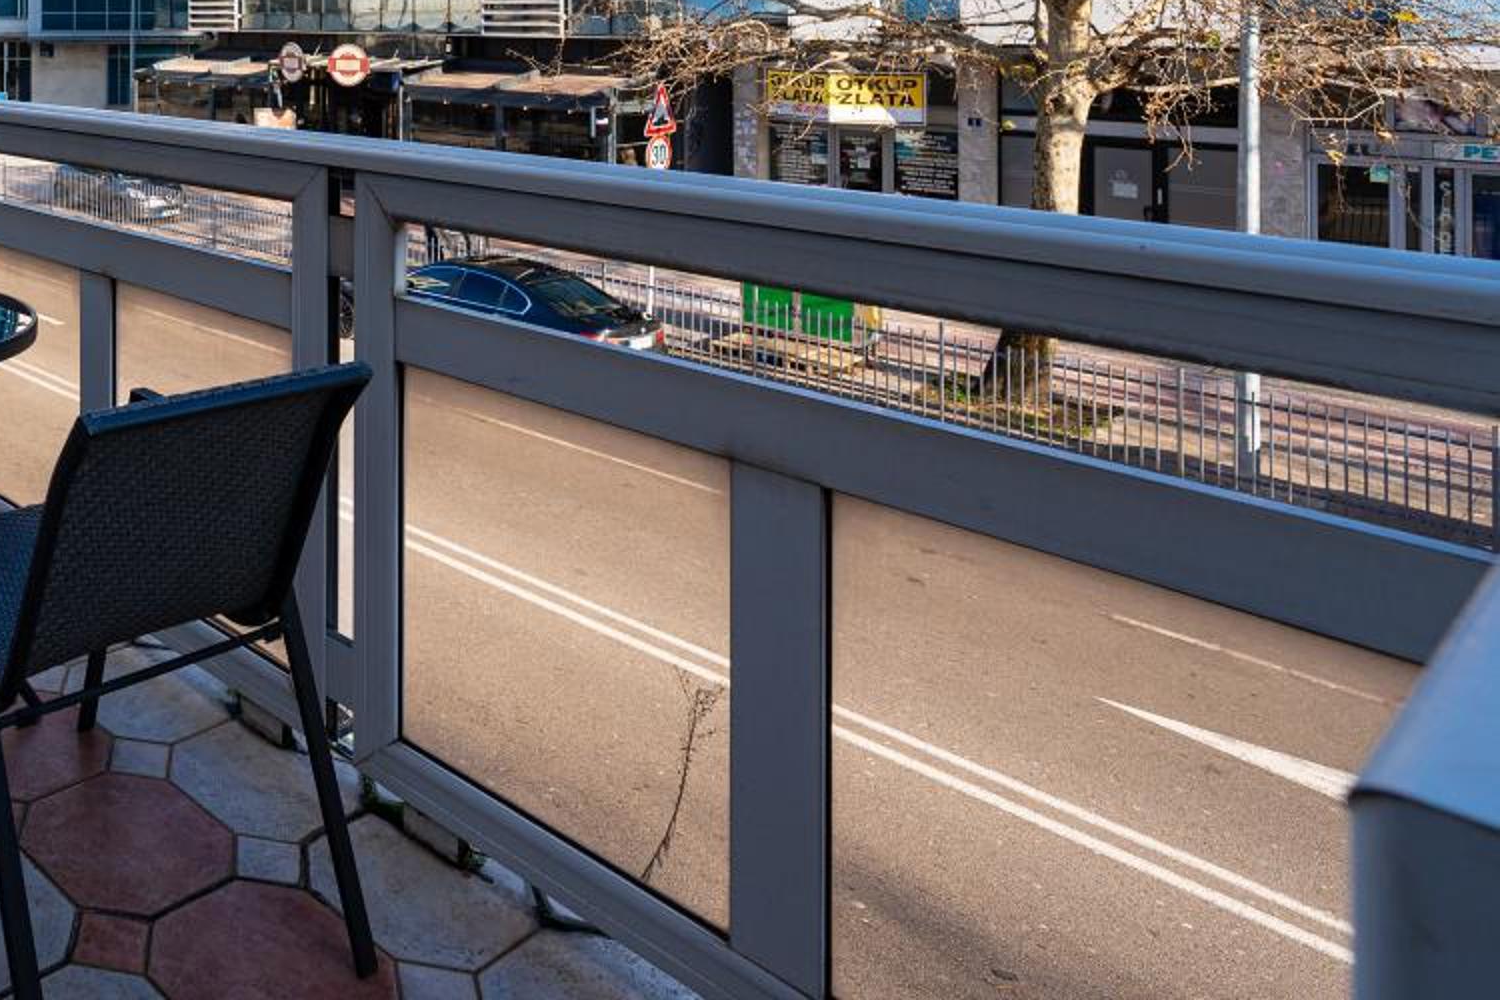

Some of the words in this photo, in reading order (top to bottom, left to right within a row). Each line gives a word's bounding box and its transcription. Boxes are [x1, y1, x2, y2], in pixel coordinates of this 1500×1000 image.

[837, 78, 918, 91] OTKUP
[838, 93, 916, 107] ZLATA
[652, 144, 666, 166] 30
